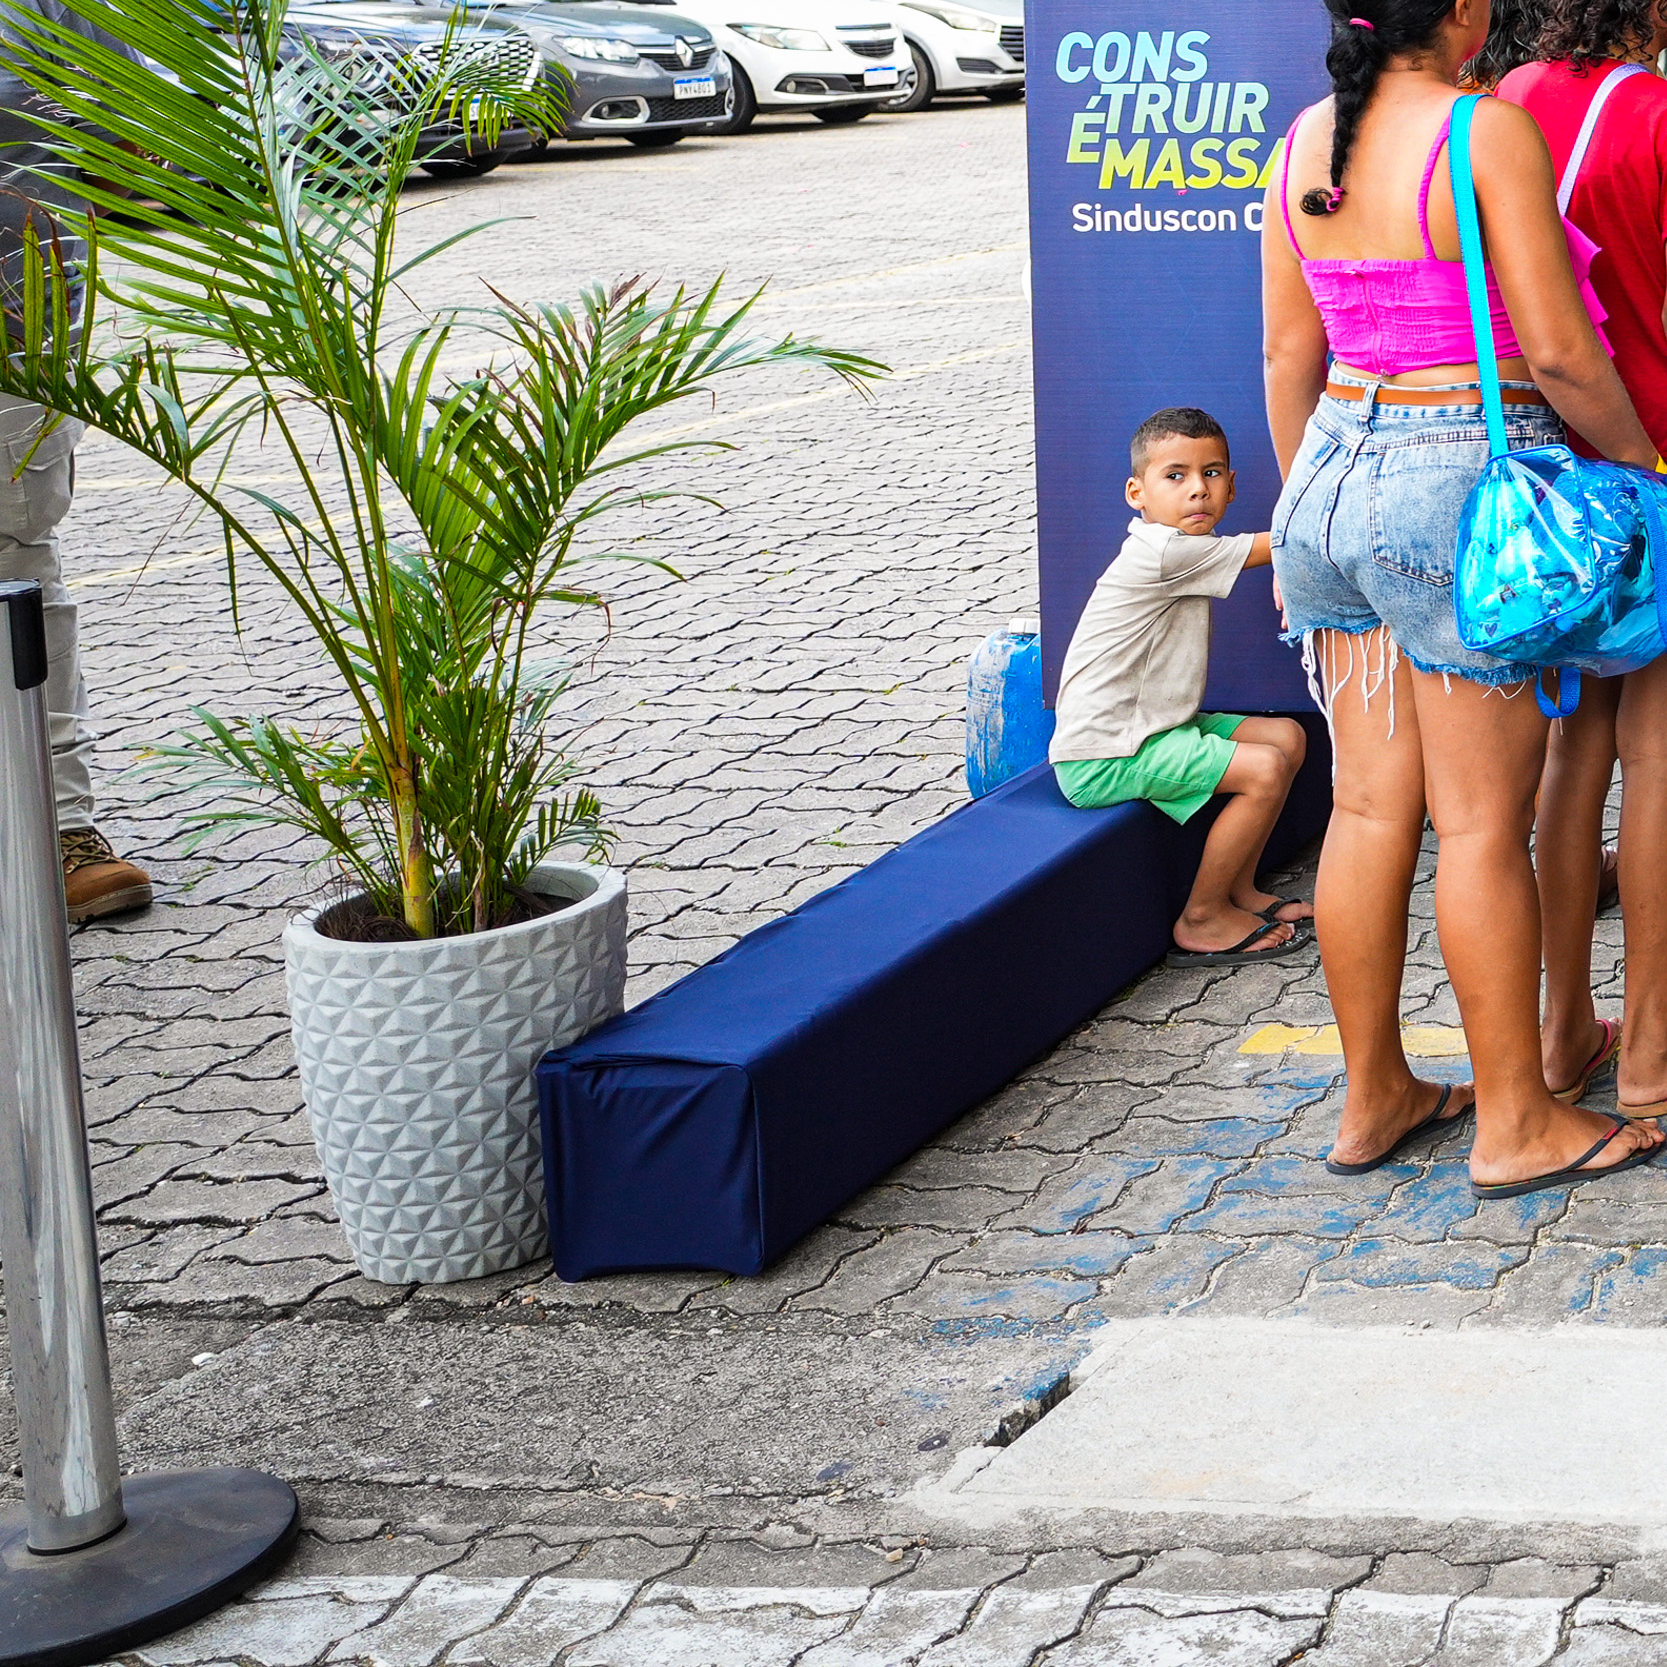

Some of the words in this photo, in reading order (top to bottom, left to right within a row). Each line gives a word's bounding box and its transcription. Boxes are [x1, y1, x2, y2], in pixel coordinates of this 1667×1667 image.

[1056, 31, 1211, 83] CONS
[1066, 95, 1107, 163] É
[1100, 82, 1269, 134] TRUIR
[1072, 203, 1236, 232] Sinduscon
[1244, 202, 1264, 232] C
